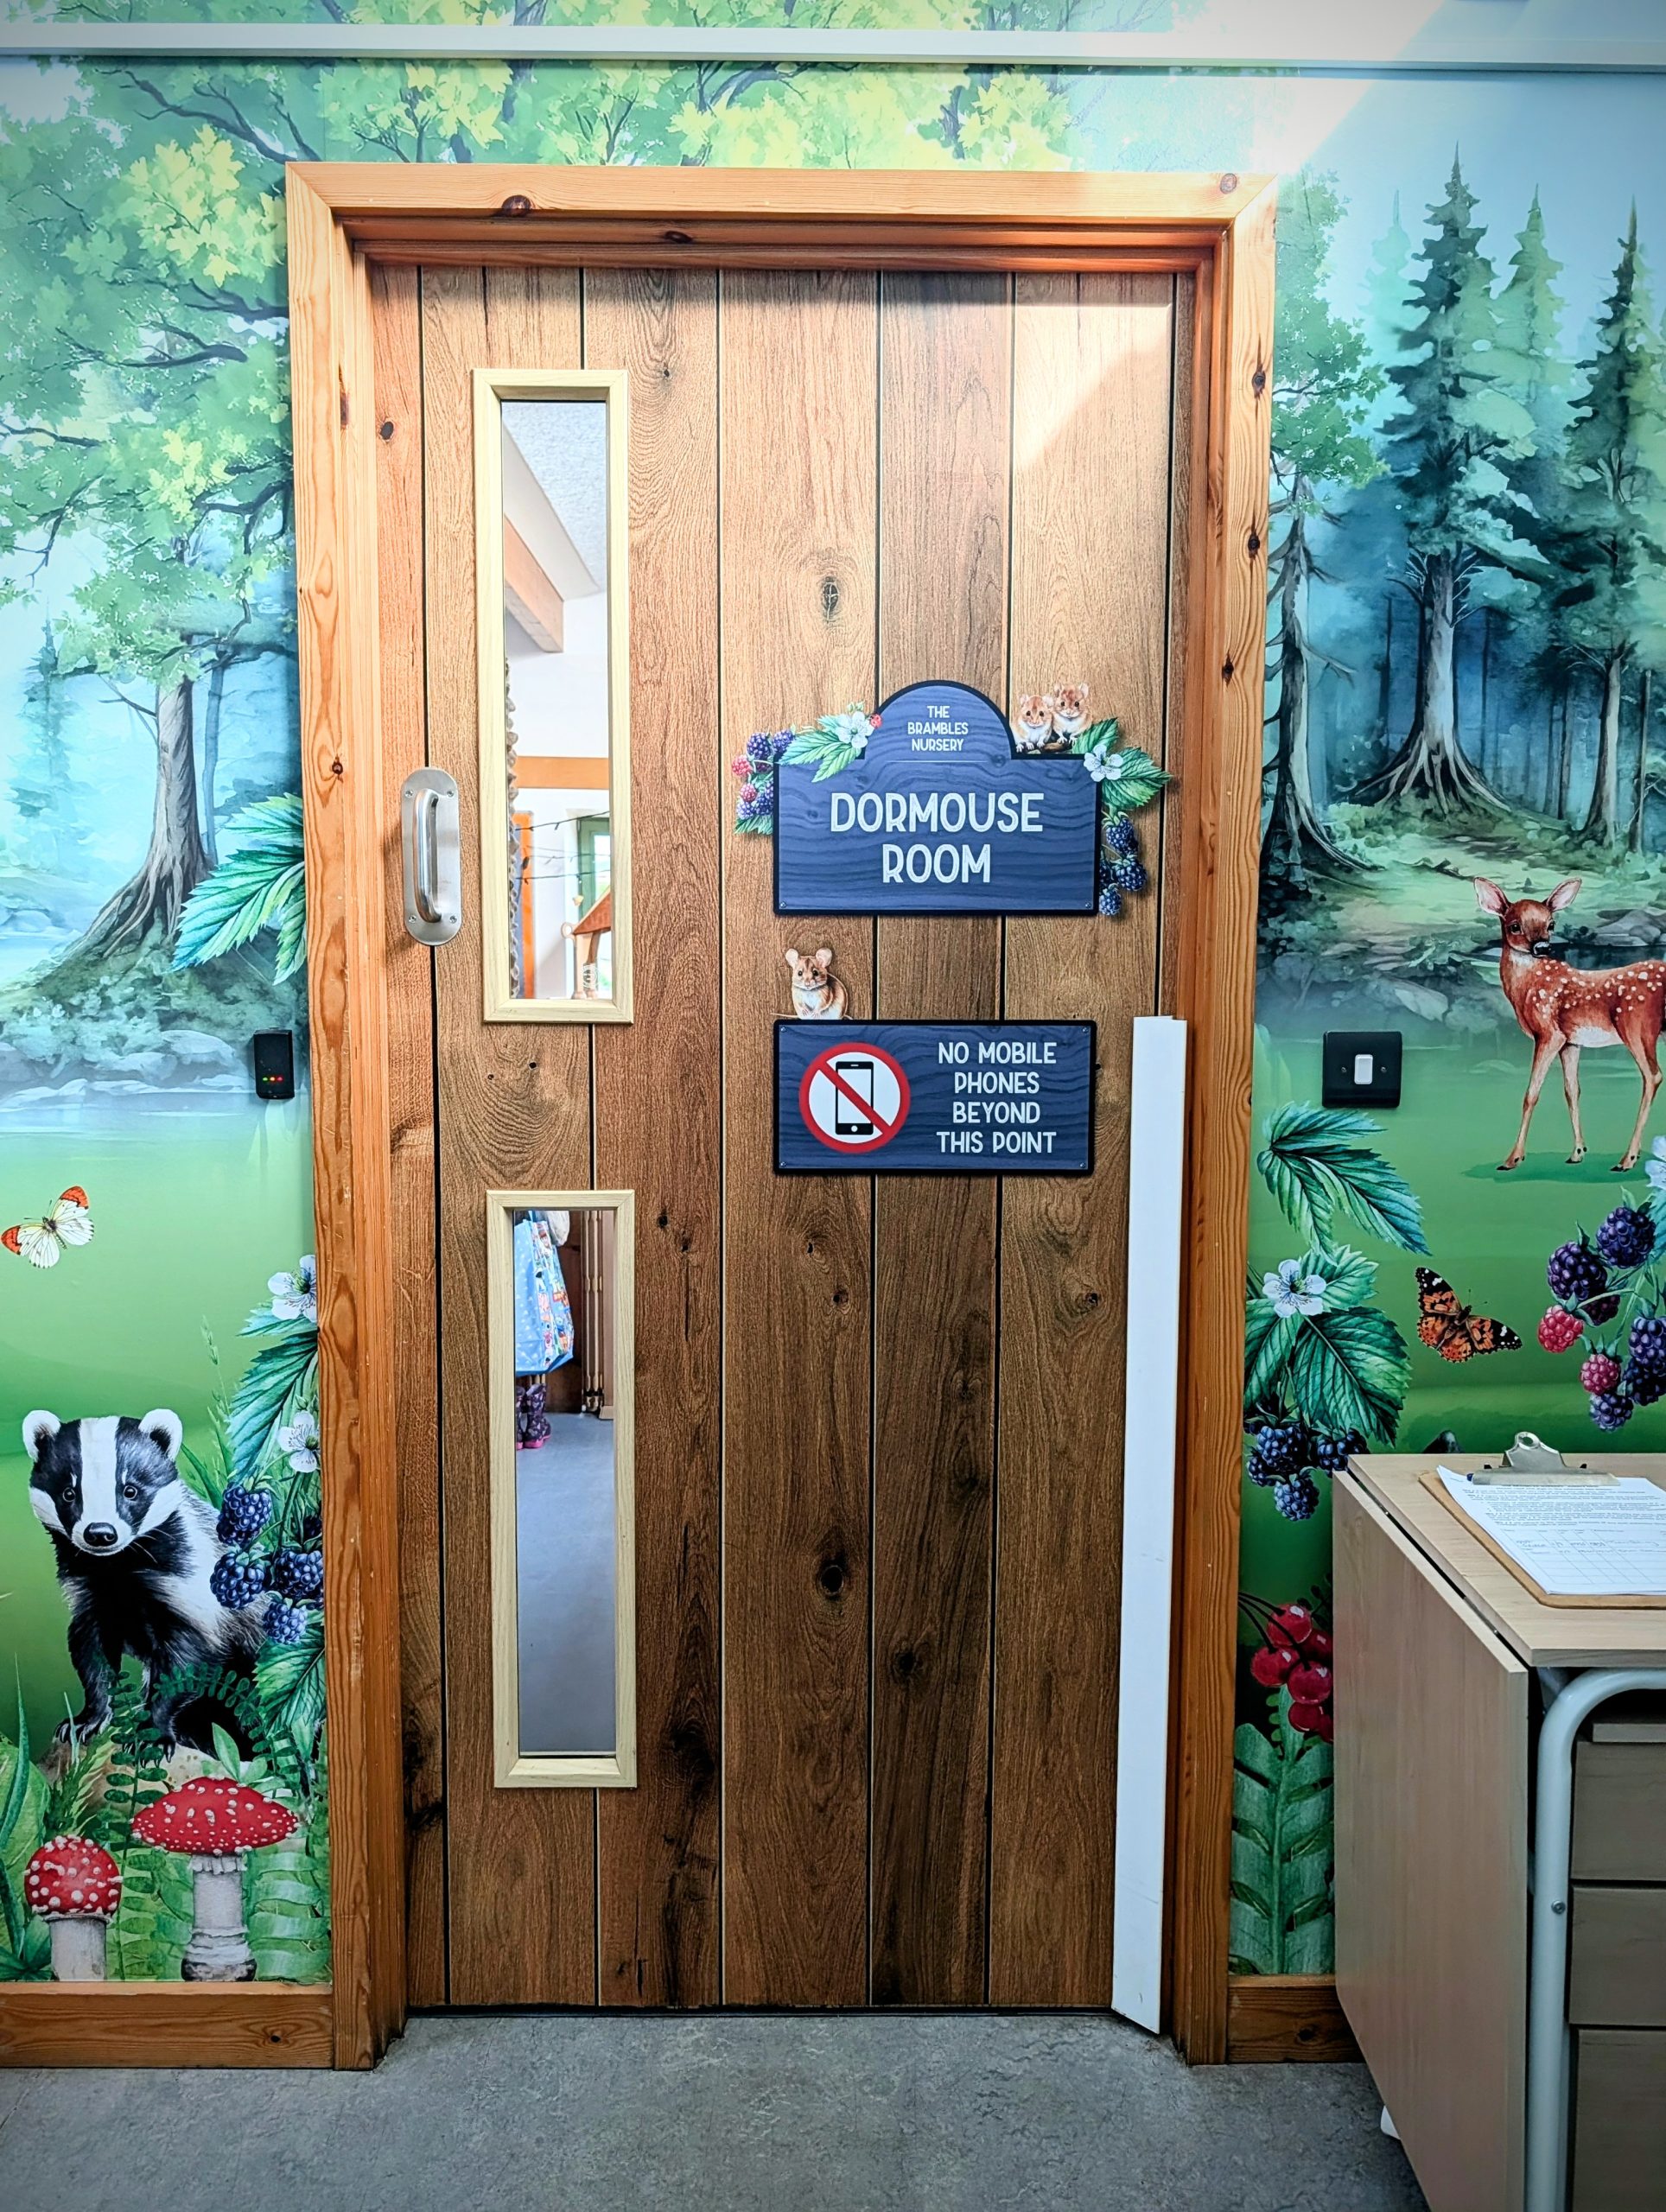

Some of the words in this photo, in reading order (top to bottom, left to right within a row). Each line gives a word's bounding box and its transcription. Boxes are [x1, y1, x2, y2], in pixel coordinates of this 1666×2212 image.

[926, 705, 951, 719] THE
[907, 721, 969, 735] BRAMBLES
[911, 738, 964, 752] NURSERY
[830, 791, 1044, 833] DORMOUSE
[882, 843, 991, 883] ROOM
[938, 1041, 970, 1064] NO
[978, 1041, 1057, 1064] MOBILE
[954, 1071, 1040, 1094] PHONES
[953, 1101, 1040, 1124] BEYOND
[936, 1131, 983, 1154] THIS
[993, 1131, 1057, 1154] POINT
